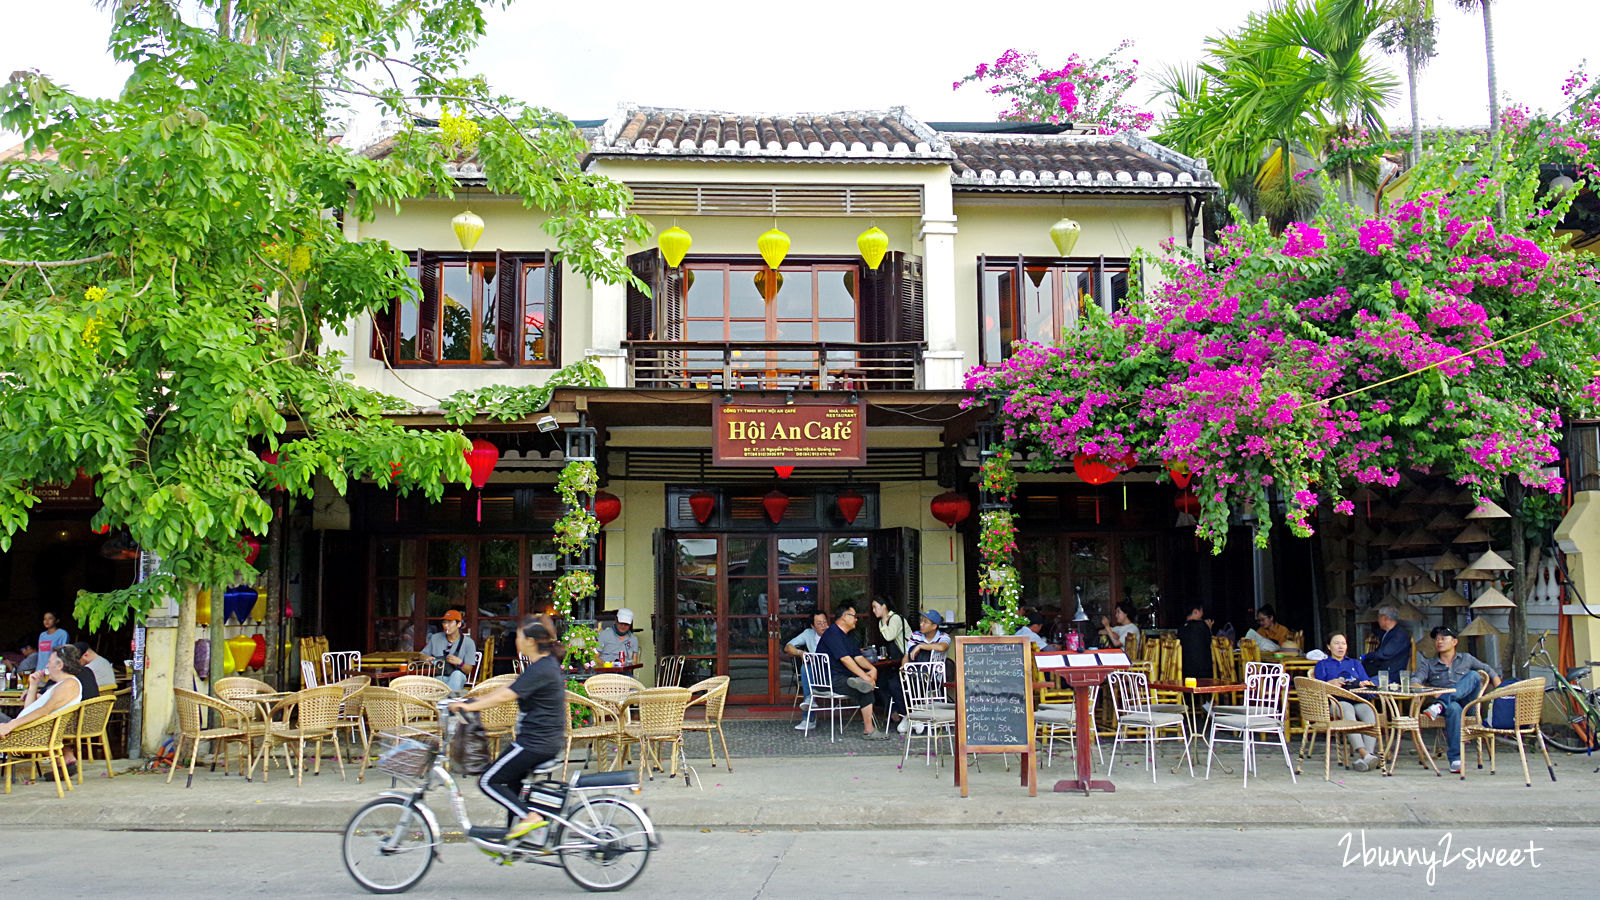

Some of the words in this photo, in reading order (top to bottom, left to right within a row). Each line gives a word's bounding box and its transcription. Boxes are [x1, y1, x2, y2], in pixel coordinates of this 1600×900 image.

[728, 420, 766, 444] Hội
[770, 421, 801, 440] An
[804, 420, 852, 440] Café
[965, 644, 986, 653] Lunch
[989, 644, 1015, 655] Special
[969, 696, 984, 704] Fish
